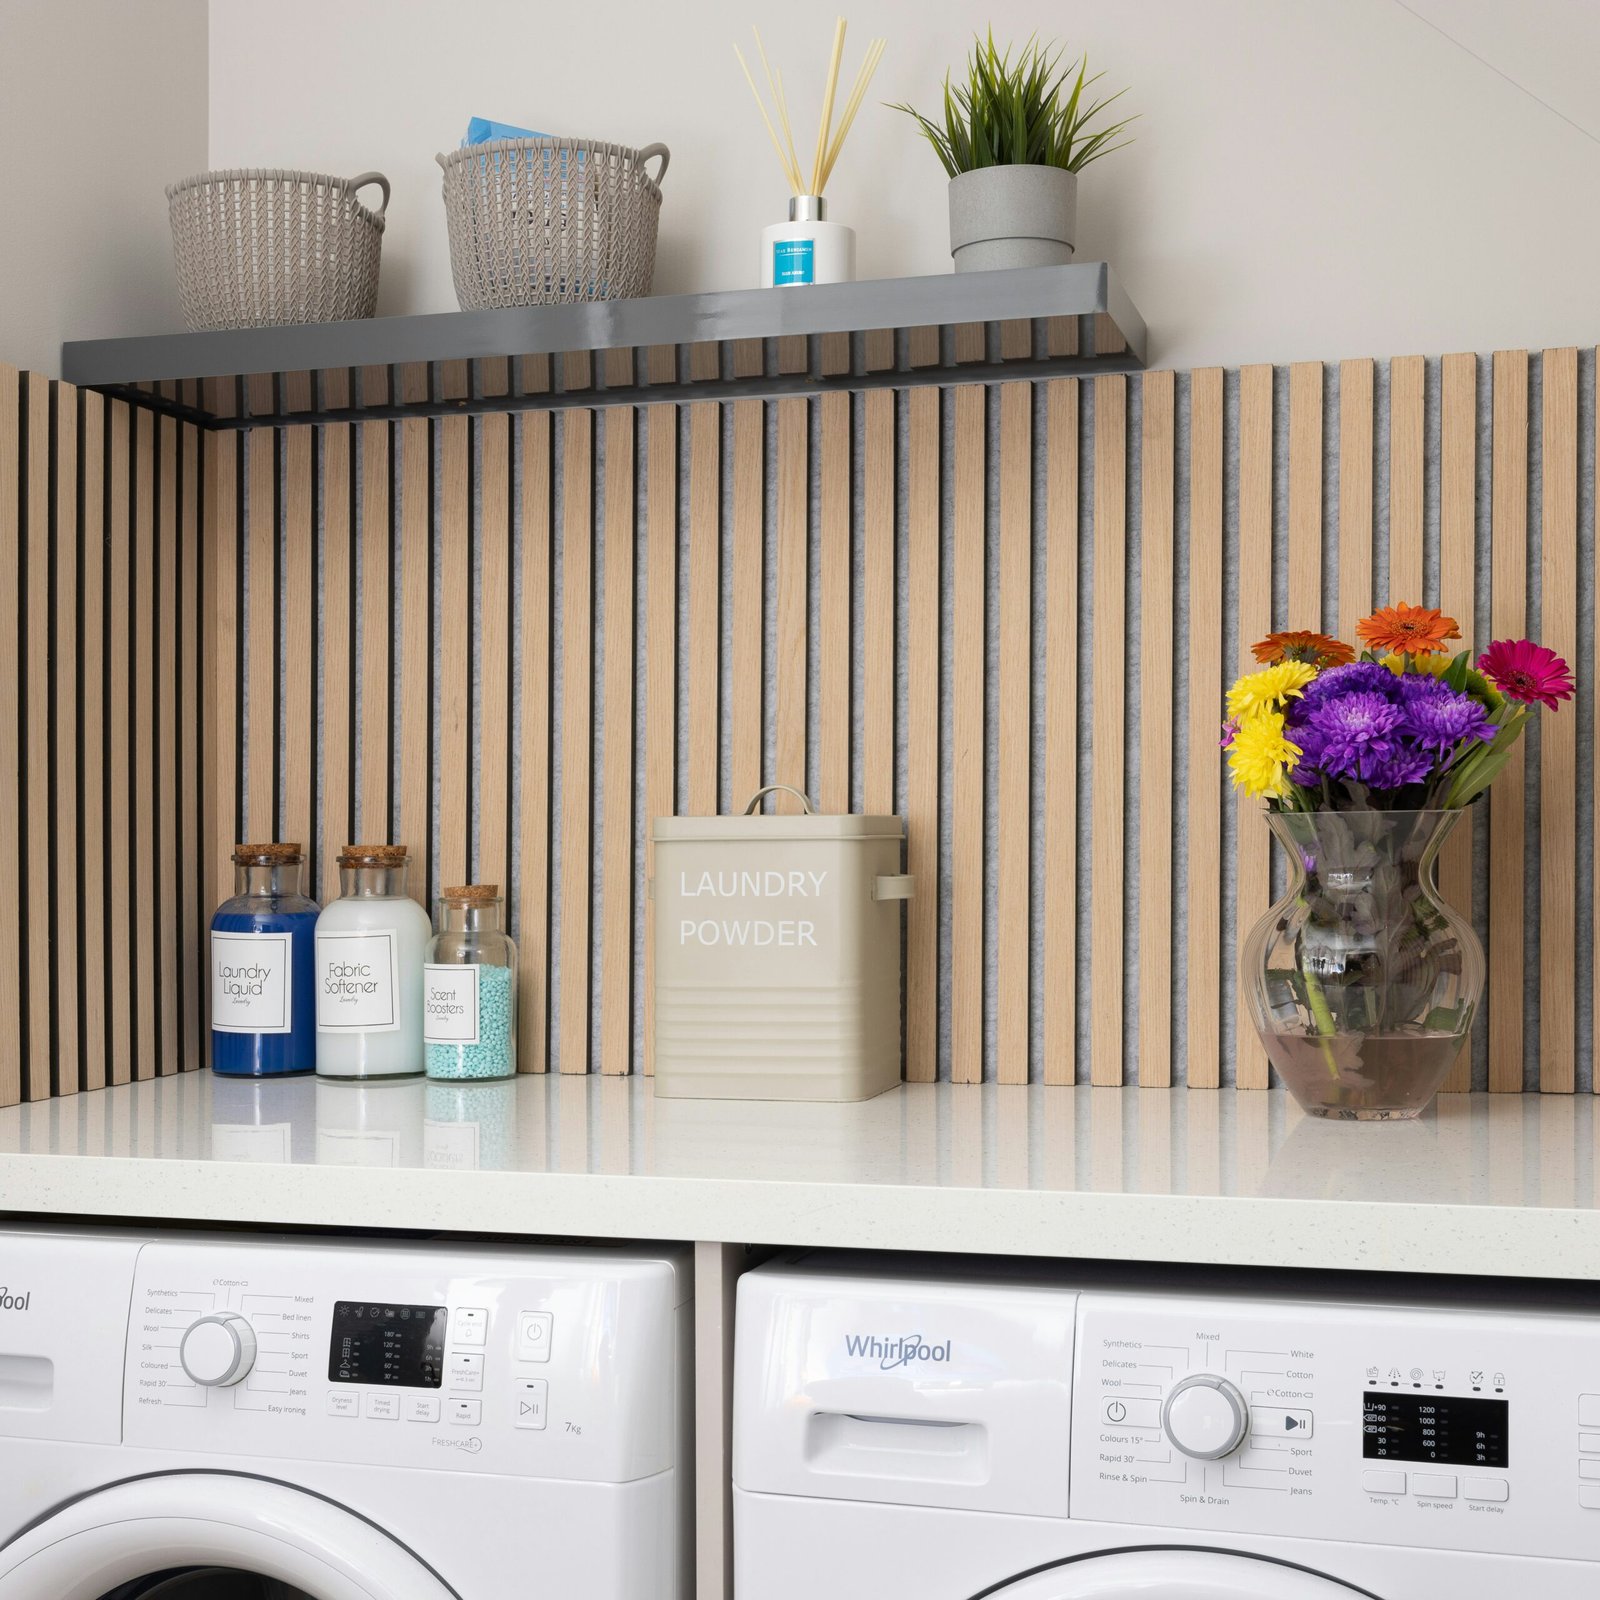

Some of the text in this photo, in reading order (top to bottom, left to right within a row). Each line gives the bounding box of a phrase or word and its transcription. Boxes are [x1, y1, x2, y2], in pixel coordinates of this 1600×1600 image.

[680, 871, 828, 898] LAUNDRY
[680, 919, 818, 946] POWDER
[218, 961, 271, 982] Laundry
[328, 961, 371, 978] Fabric
[223, 978, 263, 998] Liquid
[325, 977, 378, 994] Softener
[430, 987, 456, 1001] Scent
[427, 1000, 464, 1014] Boosters
[219, 1279, 240, 1287] Cotton
[146, 1289, 178, 1298] Synthetics
[294, 1296, 314, 1304] Mixed
[145, 1307, 173, 1315] Delicates
[282, 1313, 312, 1322] Bed linen
[143, 1325, 159, 1333] Wool
[291, 1332, 310, 1341] Shirts
[1195, 1332, 1221, 1342] Mixed
[141, 1343, 153, 1351] Silk
[1103, 1339, 1143, 1349] Synthetics
[291, 1352, 309, 1360] Sport
[845, 1334, 952, 1371] Whirlpool
[1291, 1350, 1314, 1359] White
[140, 1362, 169, 1370] Coloured
[1102, 1360, 1137, 1369] Delicates
[288, 1370, 308, 1378] Duvet
[1286, 1370, 1314, 1379] Cotton
[139, 1379, 156, 1388] Rapid
[1101, 1379, 1121, 1387] Wool
[288, 1388, 307, 1396] Jeans
[1275, 1389, 1303, 1398] Cotton
[138, 1397, 162, 1406] Refresh
[332, 1397, 353, 1405] Dryness
[374, 1399, 391, 1407] Timed
[267, 1405, 306, 1416] Easy ironing
[373, 1406, 390, 1414] drying
[416, 1409, 430, 1417] delay
[1419, 1406, 1435, 1414] 1200
[1419, 1417, 1435, 1425] 1000
[1422, 1428, 1435, 1436] 800
[1476, 1431, 1485, 1439] 9h
[1099, 1434, 1128, 1444] Colours
[1290, 1447, 1313, 1457] Sport
[1099, 1454, 1122, 1463] Rapid
[1288, 1467, 1313, 1476] Duvet
[1099, 1473, 1121, 1481] Rinse
[1129, 1475, 1148, 1484] Spin
[1290, 1487, 1313, 1496] Jeans
[1180, 1494, 1230, 1506] Spin & Drain
[1370, 1497, 1389, 1505] Temp.
[1417, 1500, 1453, 1510] Spin speed
[1469, 1504, 1505, 1514] Start delay
